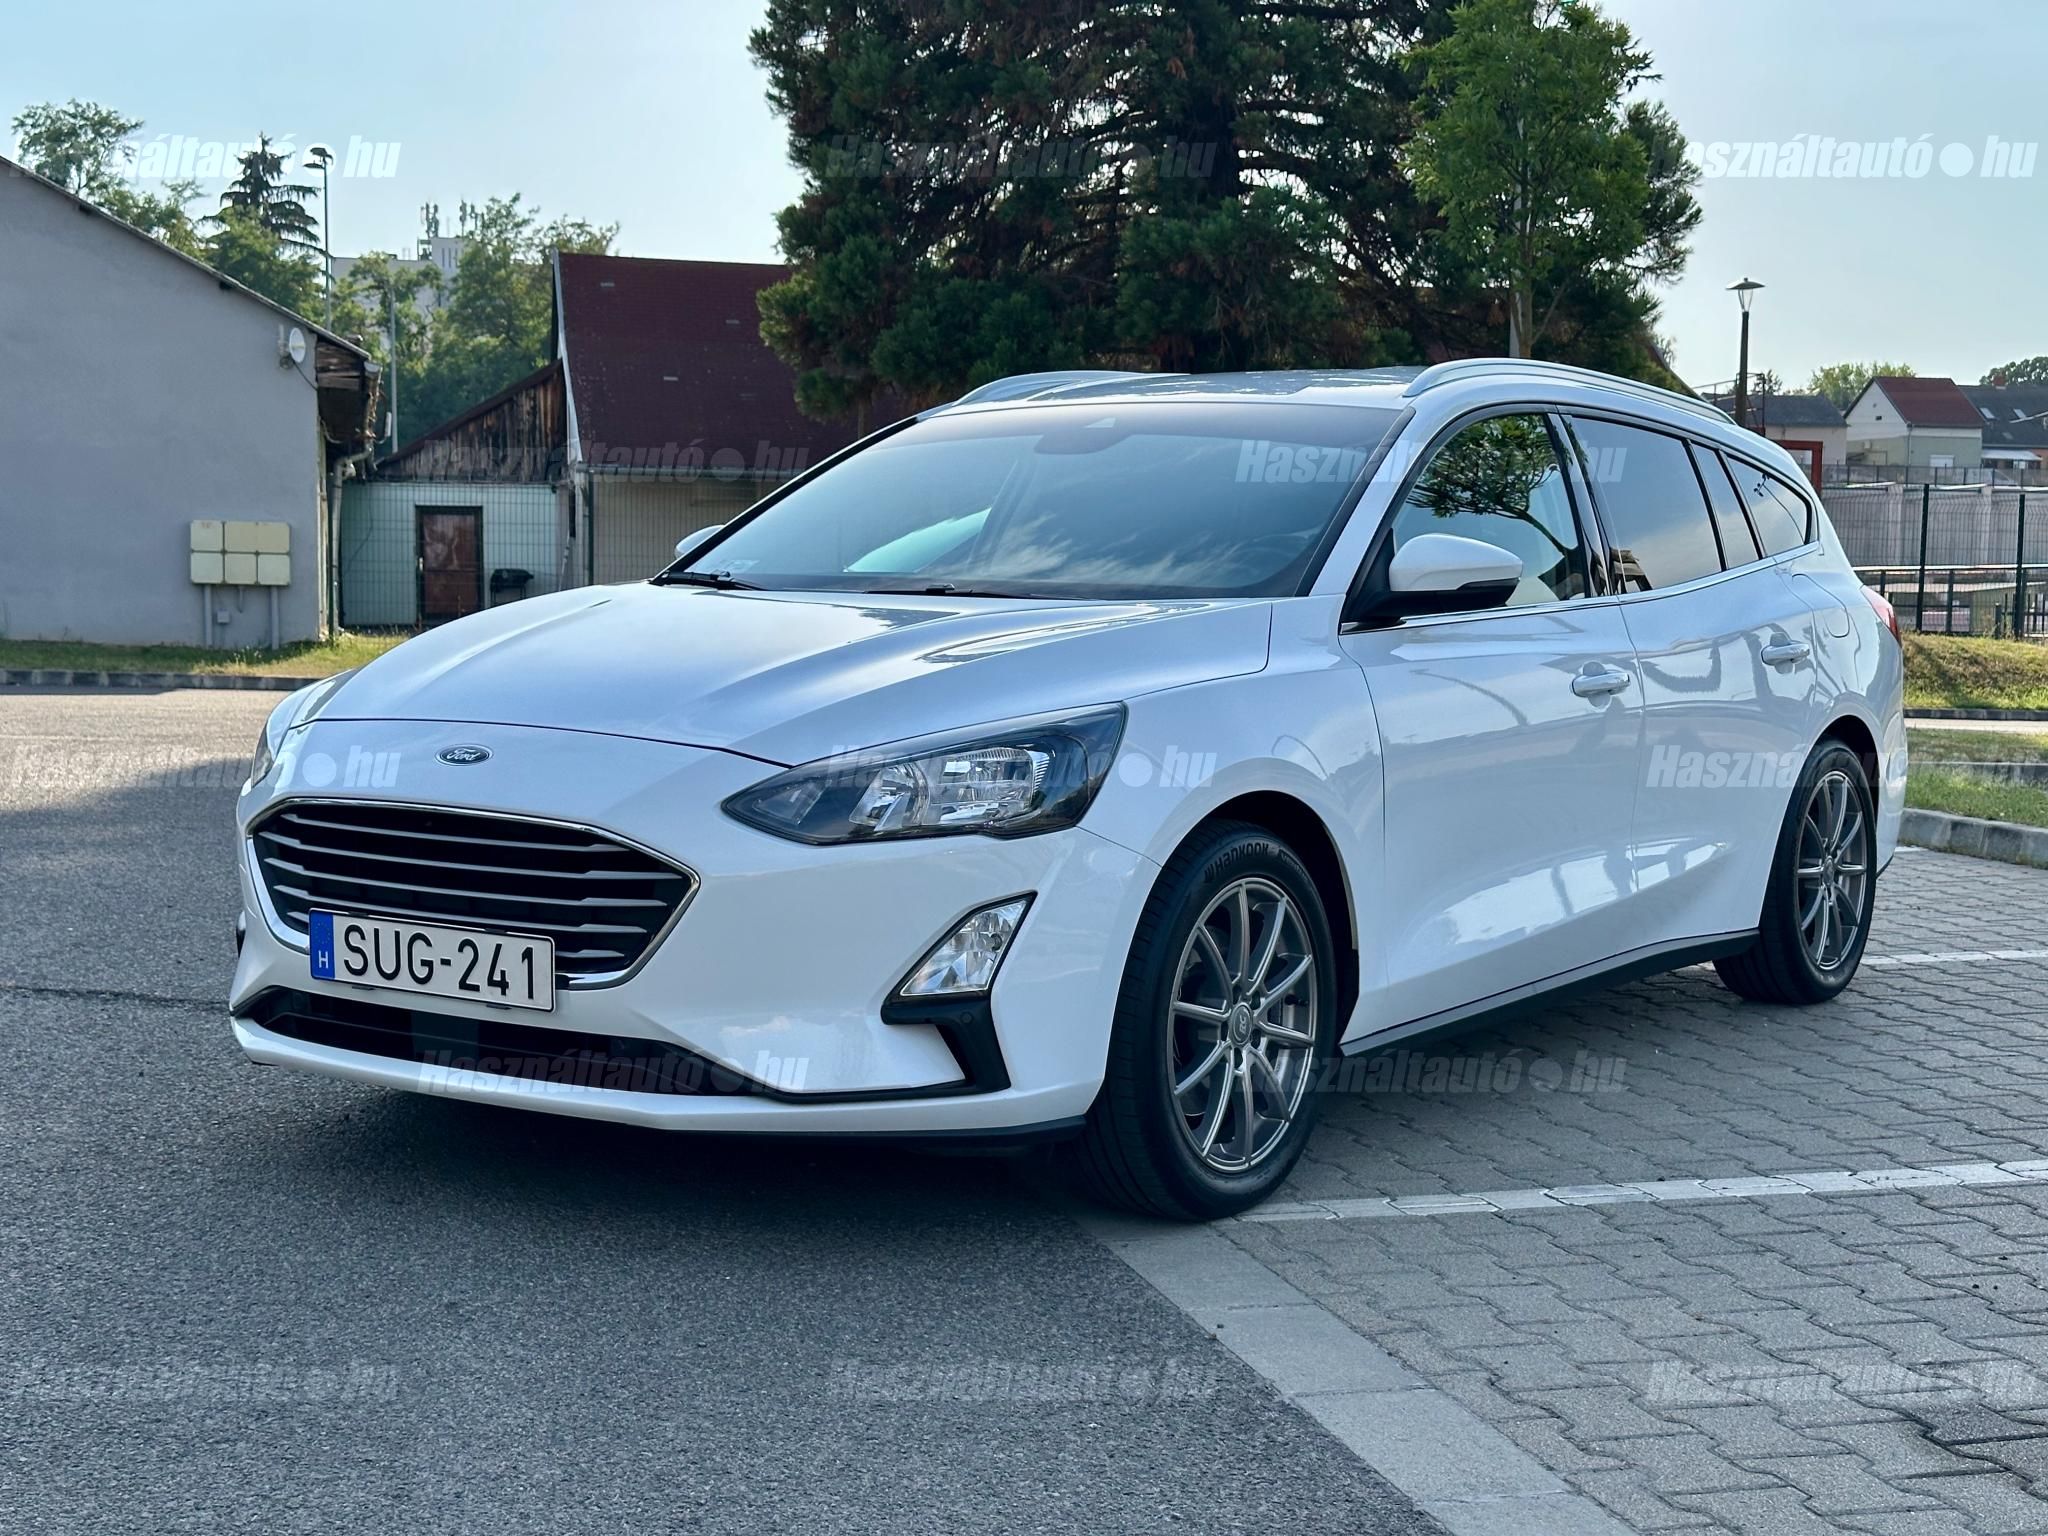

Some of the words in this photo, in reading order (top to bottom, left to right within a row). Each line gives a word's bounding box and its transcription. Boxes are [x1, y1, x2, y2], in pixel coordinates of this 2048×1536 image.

[446, 748, 481, 761] Ford
[318, 950, 329, 969] H
[343, 924, 535, 1000] SUG-241
